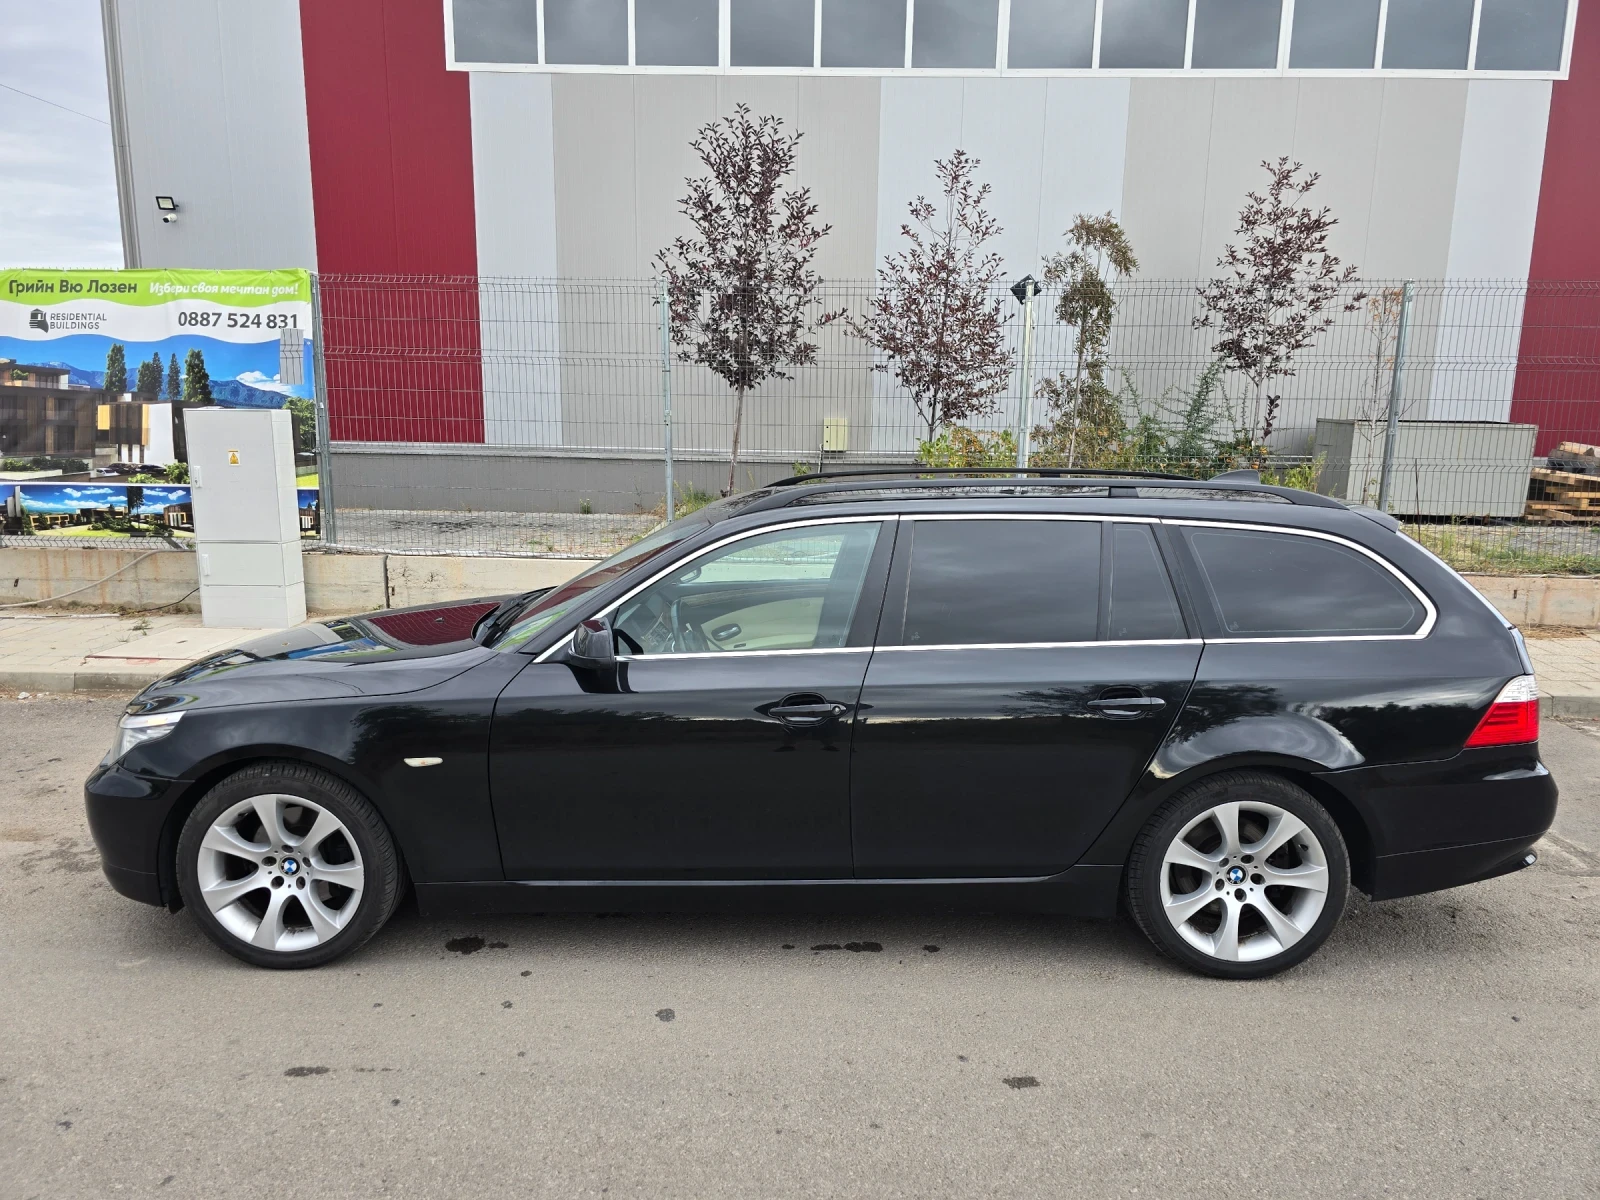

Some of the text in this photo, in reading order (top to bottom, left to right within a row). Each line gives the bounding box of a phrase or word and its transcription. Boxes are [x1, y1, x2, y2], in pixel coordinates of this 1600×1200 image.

[8, 279, 137, 297] Грийн Вю Лозен
[149, 282, 299, 297] Избери своя мечтан дом!
[50, 312, 107, 322] RESIDENTIAL
[178, 311, 298, 329] 0887 524 831
[49, 321, 100, 330] BUILDINGS
